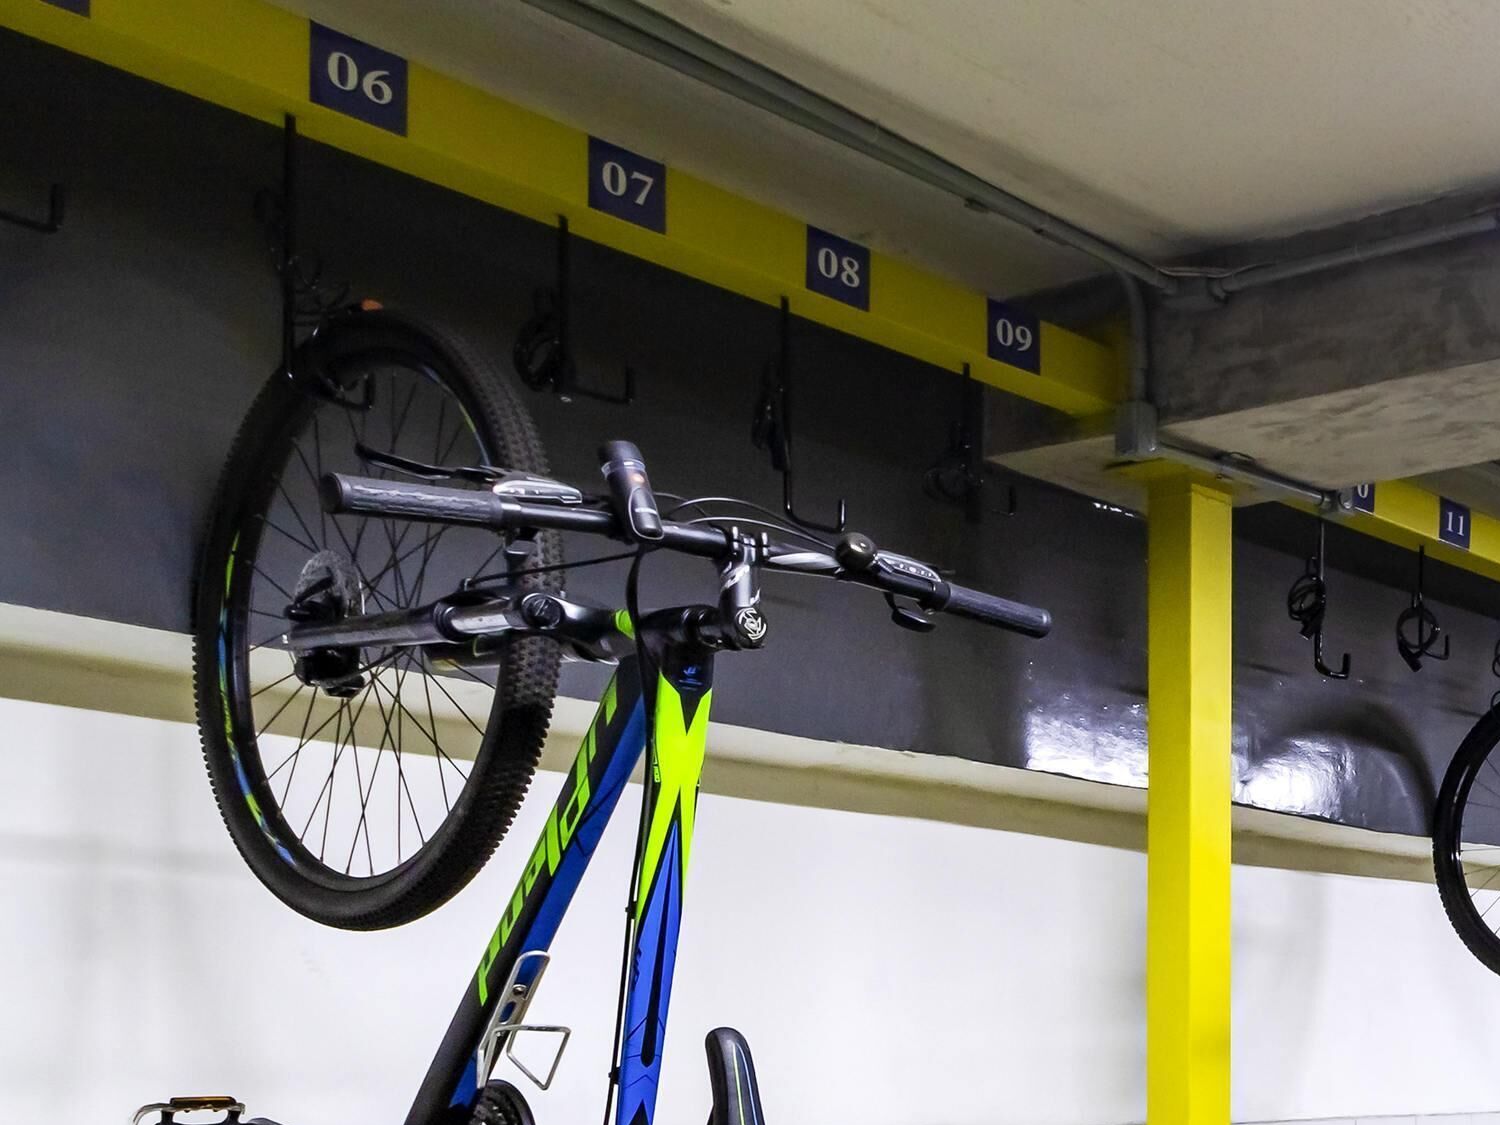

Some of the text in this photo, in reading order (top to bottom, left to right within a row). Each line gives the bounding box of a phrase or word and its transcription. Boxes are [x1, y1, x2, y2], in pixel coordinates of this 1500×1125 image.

[327, 51, 393, 105] 06
[602, 161, 654, 206] 07
[817, 247, 860, 288] 08
[996, 318, 1033, 352] 09
[1446, 511, 1465, 536] 11
